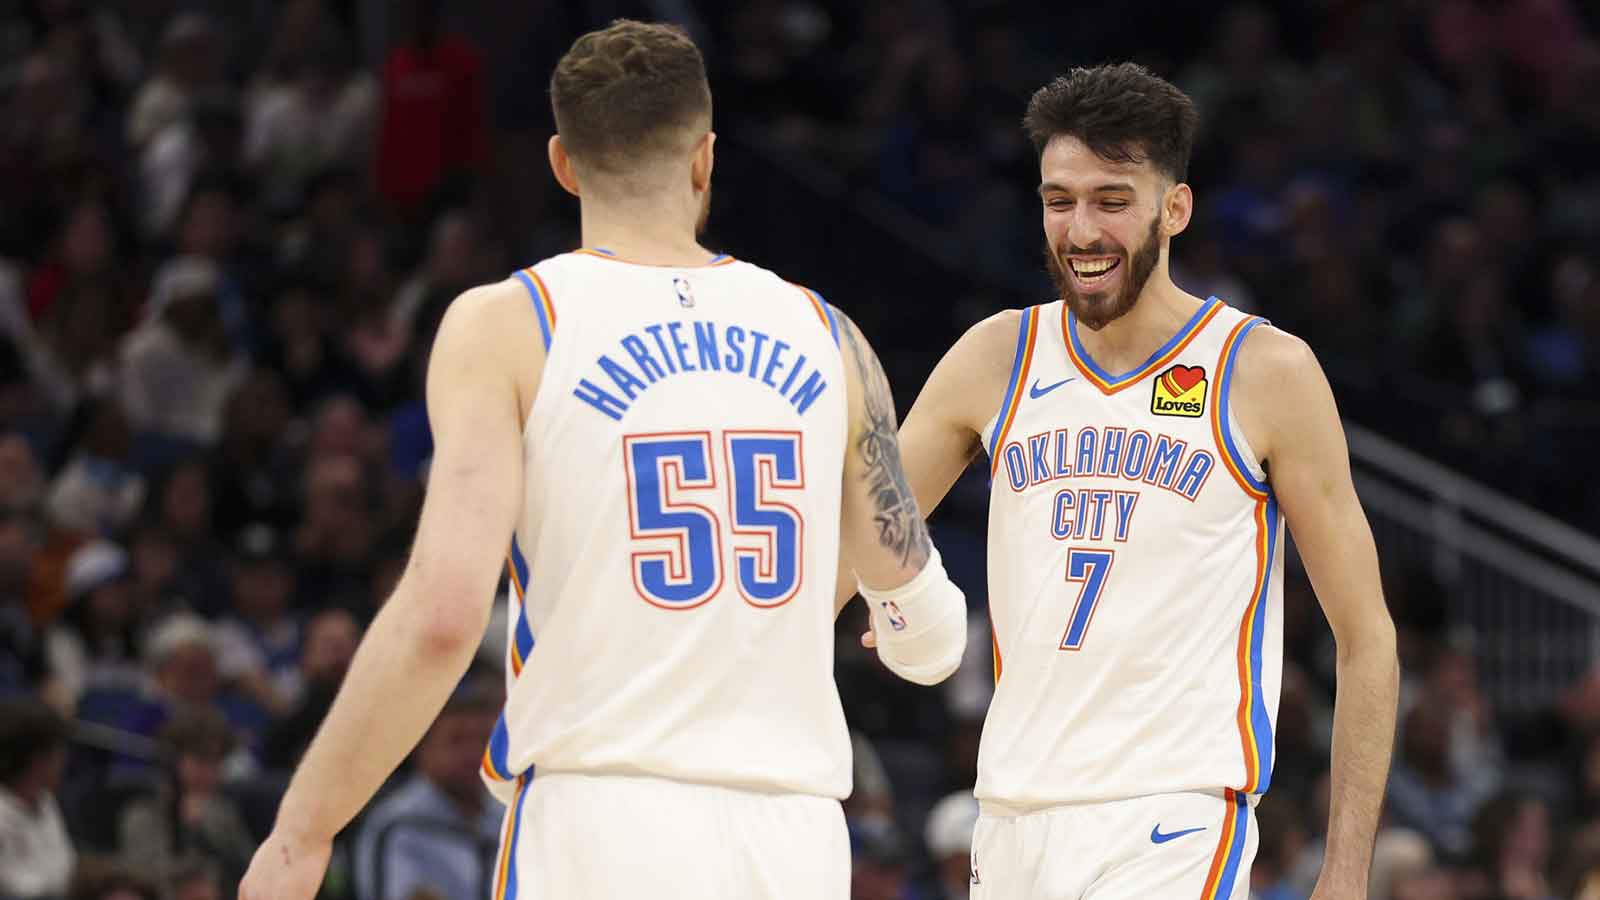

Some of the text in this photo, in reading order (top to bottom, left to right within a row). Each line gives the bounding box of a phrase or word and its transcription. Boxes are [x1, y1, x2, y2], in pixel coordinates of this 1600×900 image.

[573, 321, 827, 422] HARTENSTEIN
[1003, 426, 1215, 502] OKLAHOMA
[623, 429, 805, 610] 55
[1050, 489, 1140, 542] CITY
[1059, 547, 1115, 651] 7
